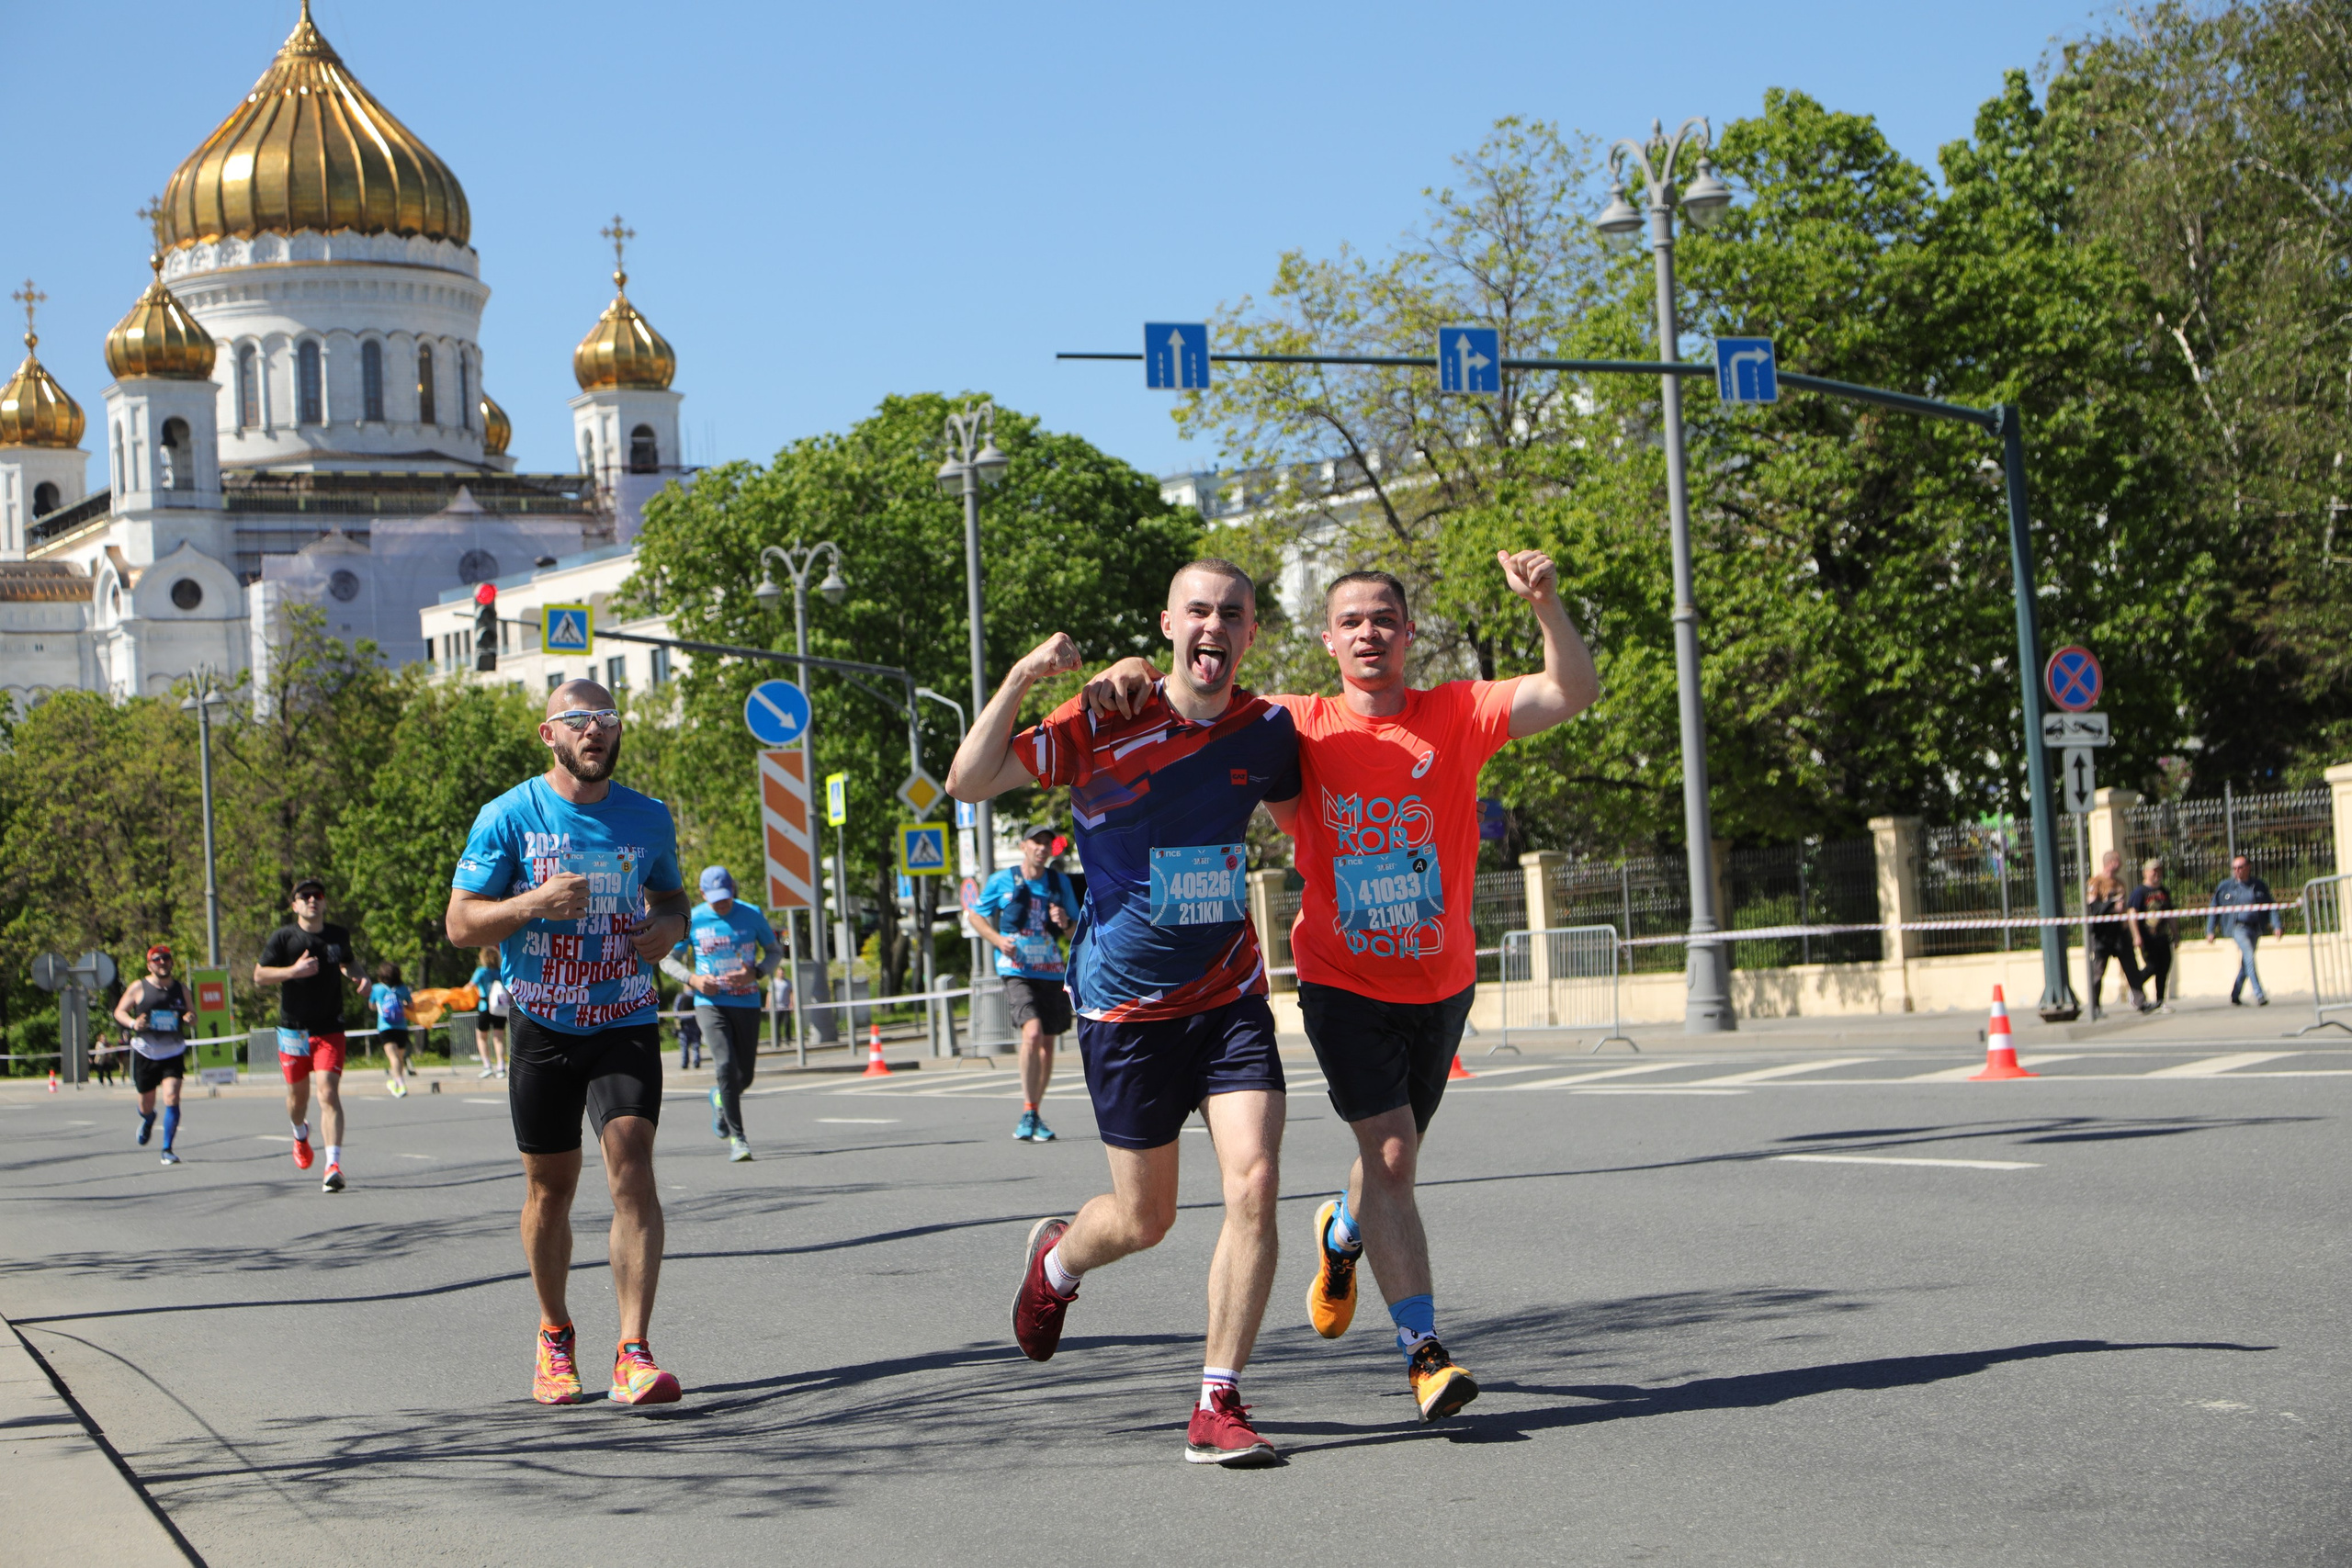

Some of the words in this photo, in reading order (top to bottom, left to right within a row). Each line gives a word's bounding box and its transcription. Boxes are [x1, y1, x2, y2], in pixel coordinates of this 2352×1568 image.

[525, 831, 572, 857] 2024
[582, 872, 622, 894] 1519
[1170, 870, 1231, 900] 40526
[1358, 872, 1421, 906] 41033
[619, 972, 652, 1002] 2024
